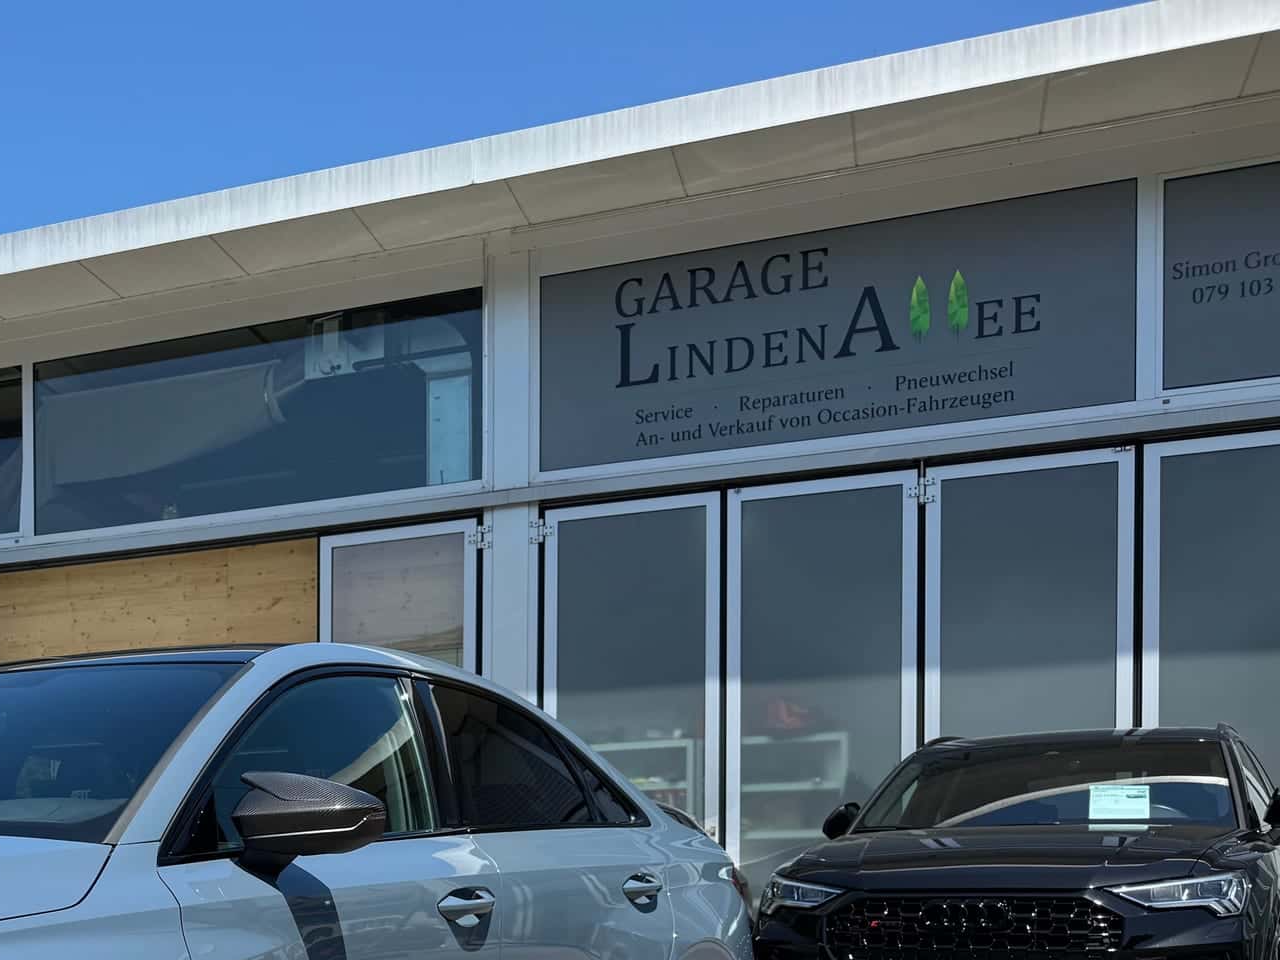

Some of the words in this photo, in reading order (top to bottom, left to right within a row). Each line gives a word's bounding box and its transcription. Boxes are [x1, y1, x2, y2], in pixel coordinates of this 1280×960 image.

[615, 247, 829, 318] GARAGE
[1172, 260, 1236, 280] Simon
[1192, 284, 1229, 304] 079
[1239, 278, 1274, 298] 103
[635, 405, 693, 425] Service
[740, 385, 845, 413] Reparaturen
[895, 360, 1014, 392] Pneuwechsel
[635, 431, 665, 447] An-
[671, 424, 702, 443] und
[709, 415, 776, 438] Verkauf
[780, 415, 811, 430] von
[817, 389, 1015, 425] Occasion-Fahrzeugen
